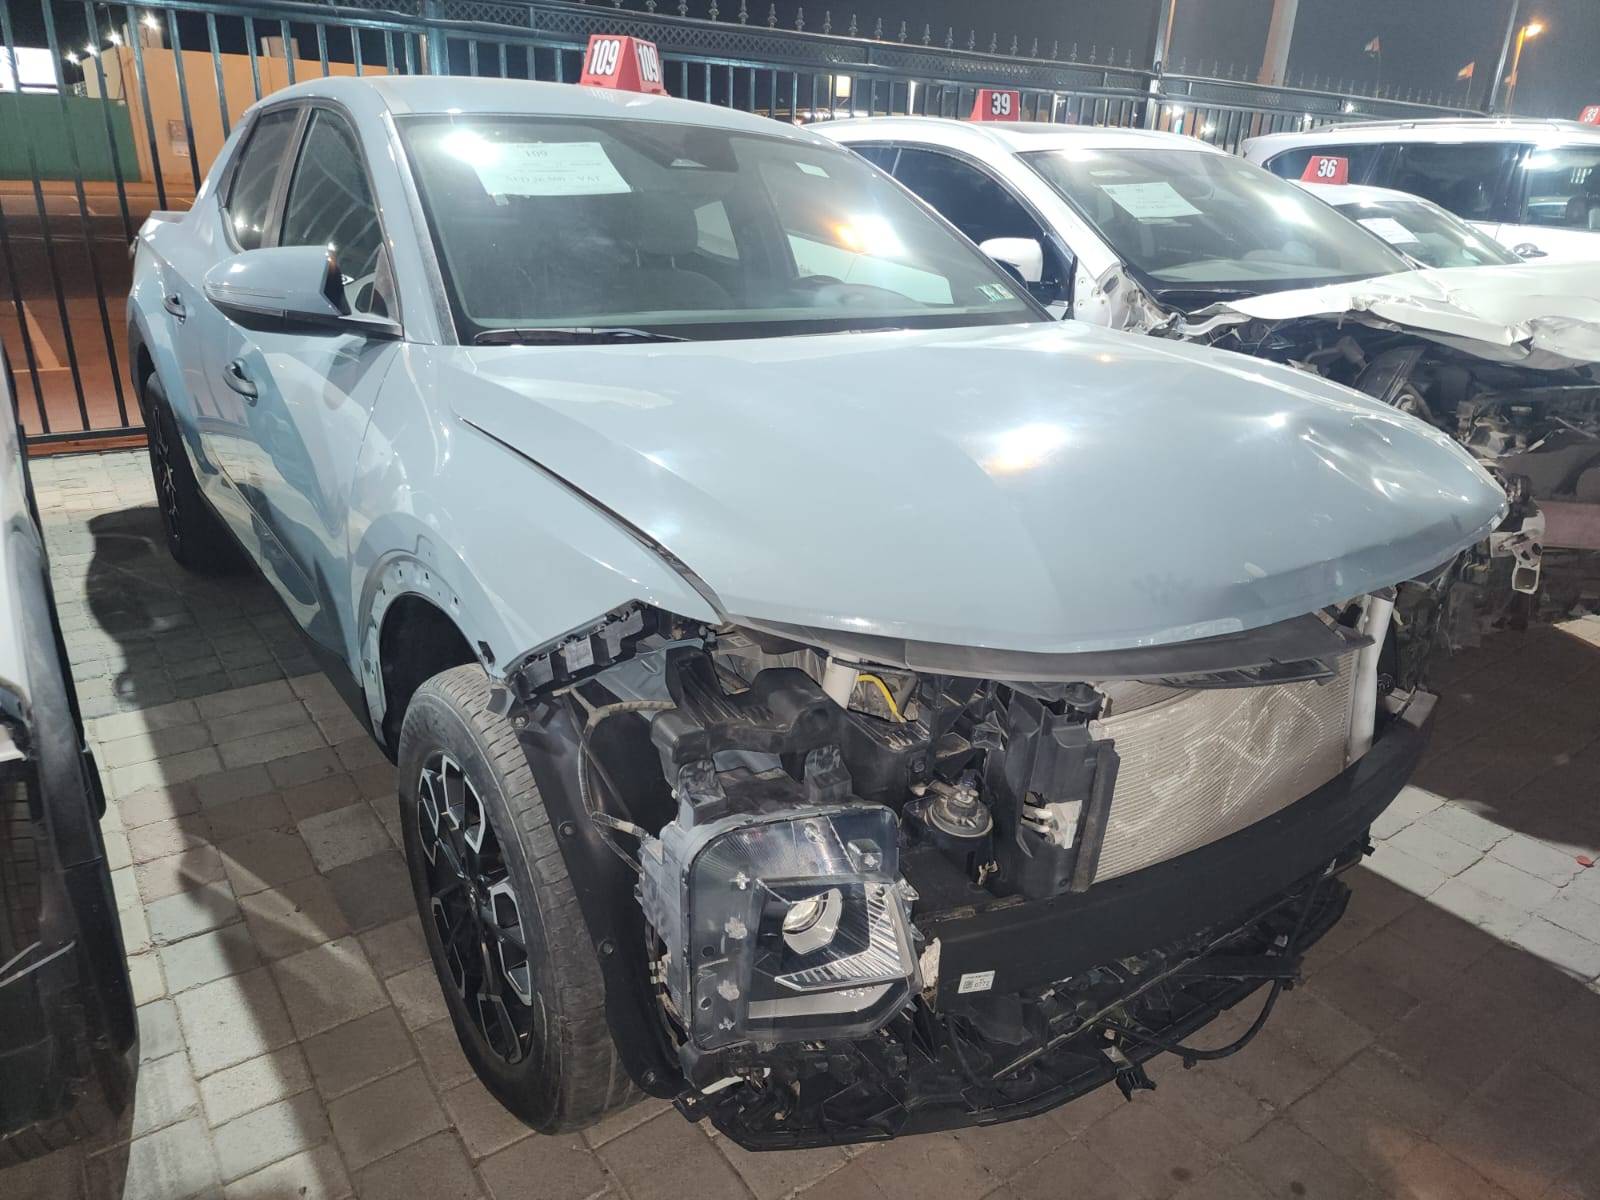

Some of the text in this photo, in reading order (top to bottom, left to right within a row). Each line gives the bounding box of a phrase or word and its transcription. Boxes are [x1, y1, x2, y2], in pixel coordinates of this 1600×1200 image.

[589, 39, 620, 75] 109
[638, 44, 659, 82] 109
[992, 92, 1011, 115] 39
[1317, 159, 1338, 178] 36
